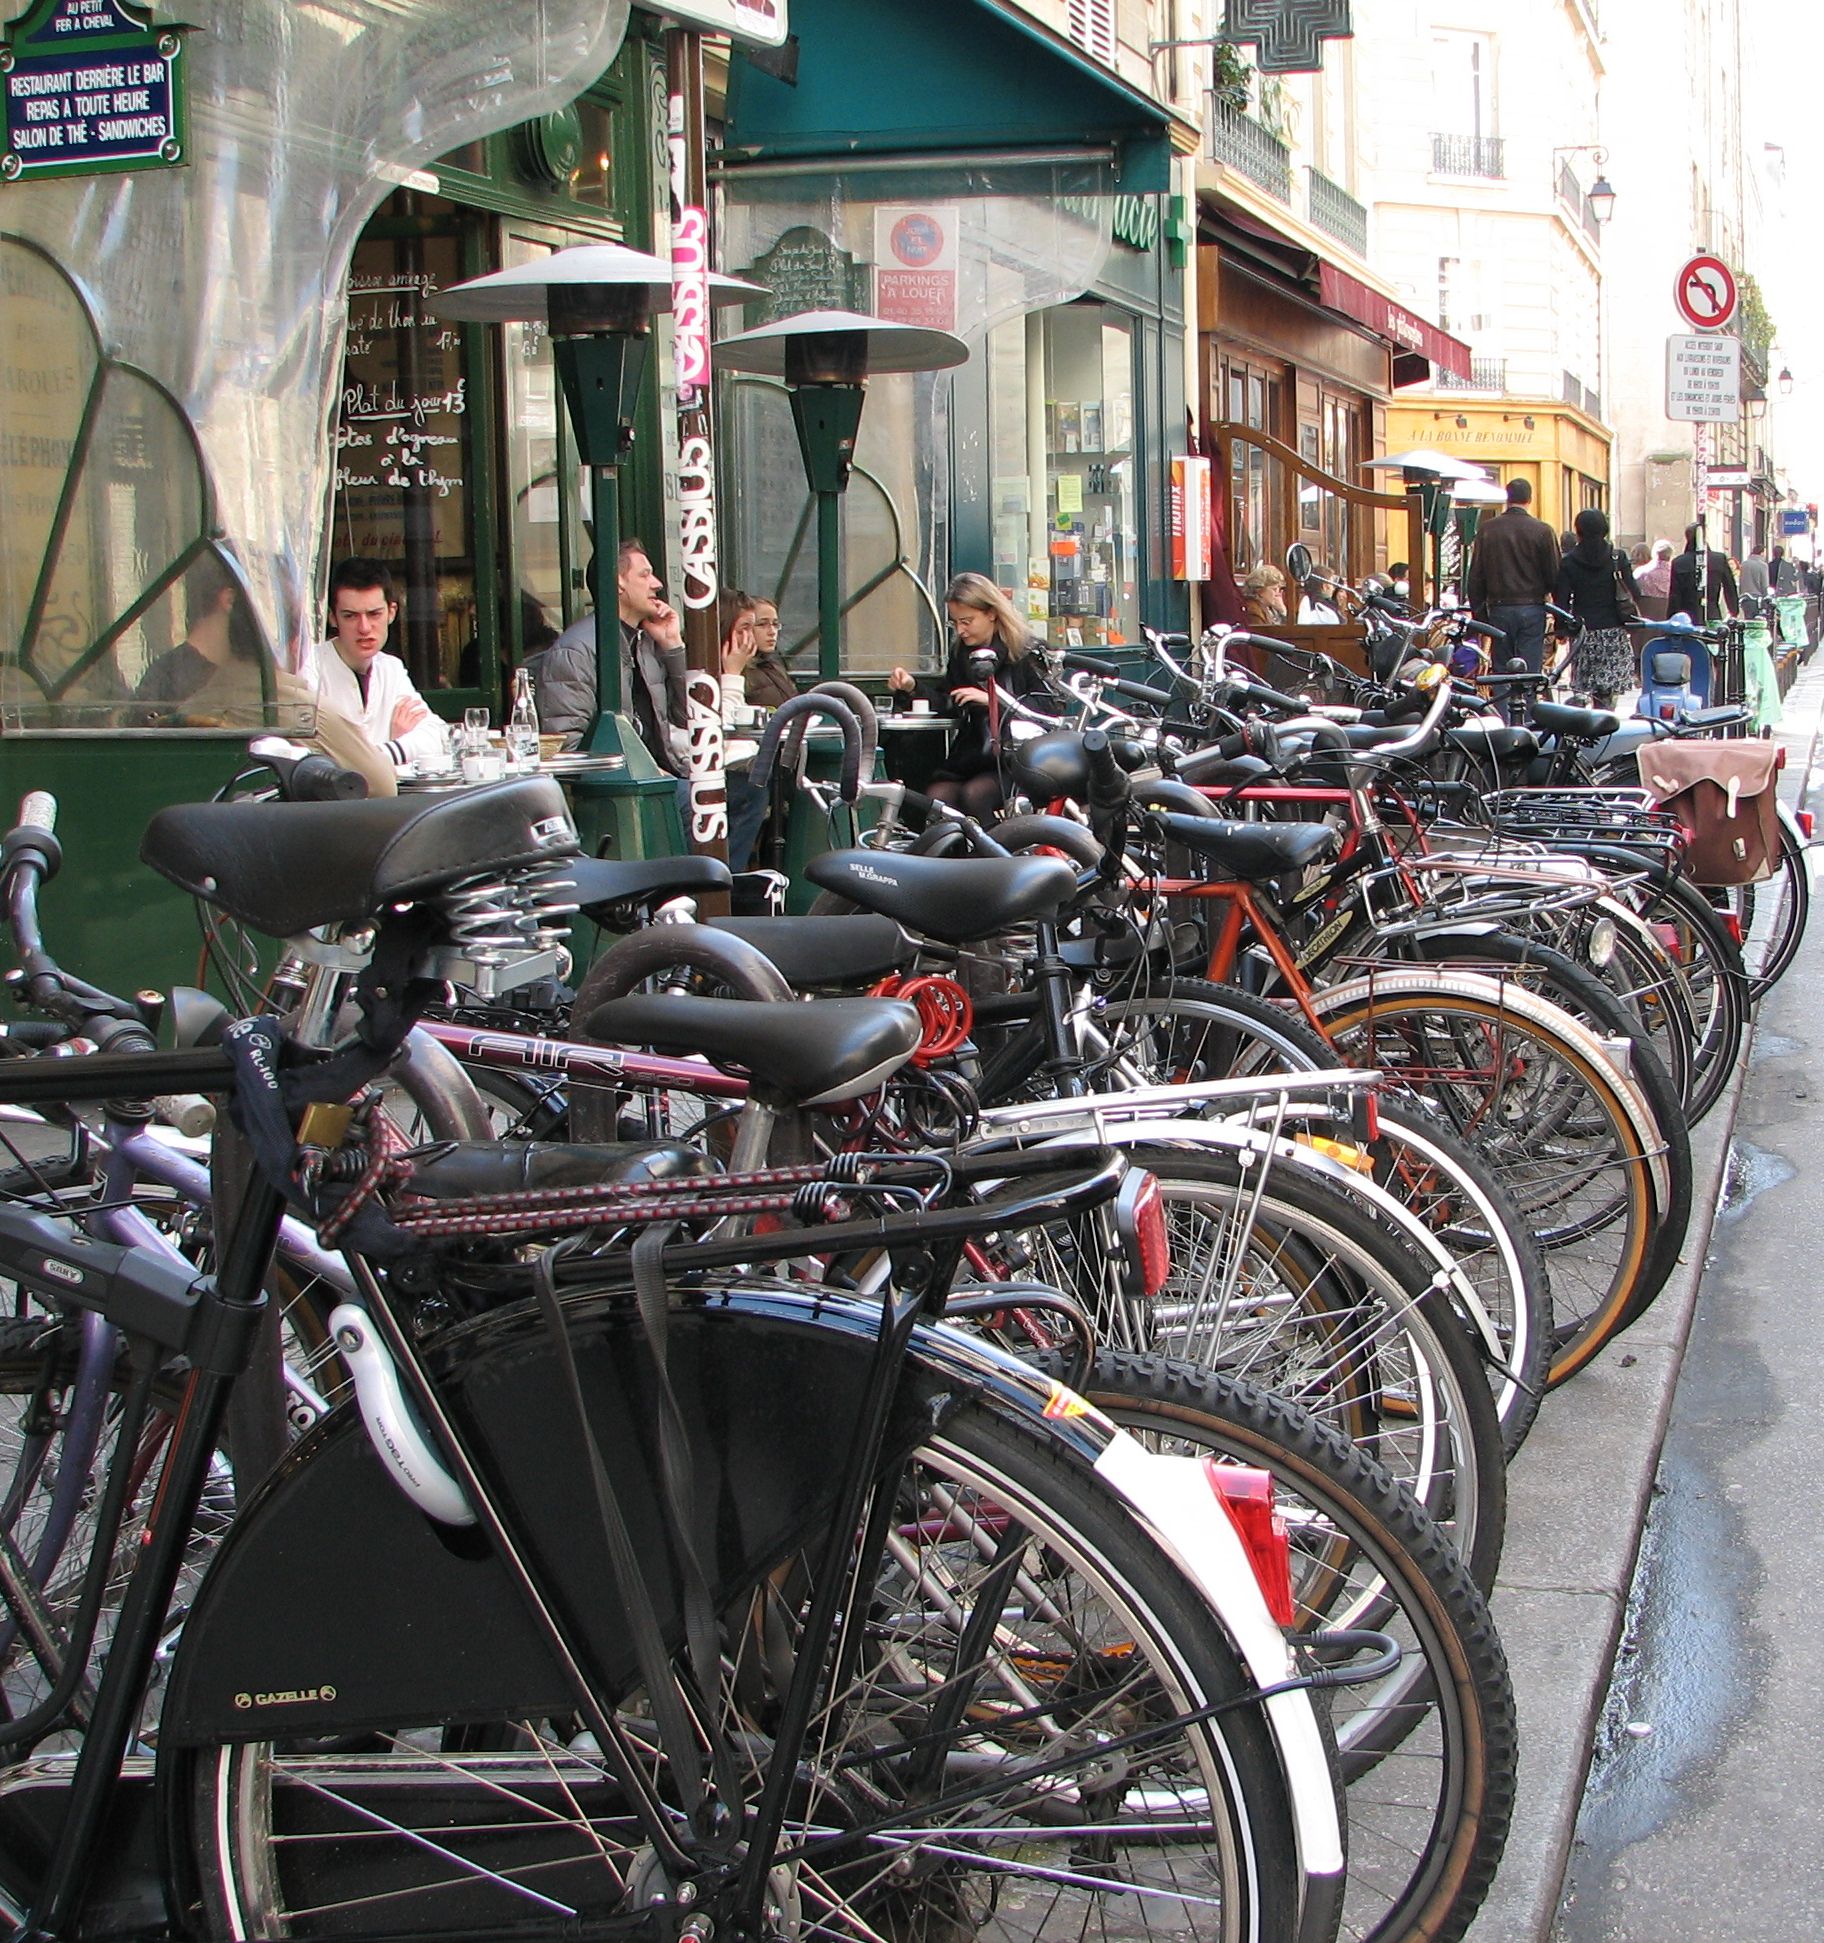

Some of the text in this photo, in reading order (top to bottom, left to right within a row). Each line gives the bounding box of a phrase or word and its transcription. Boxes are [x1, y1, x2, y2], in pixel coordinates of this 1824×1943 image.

[67, 0, 103, 15] AU PETIT
[55, 15, 115, 32] FER A CHEVAL
[11, 62, 165, 97] RESTAURANT DERRIÈRE LE BAR
[26, 90, 150, 122] REPAS A TOUTE HEURE
[13, 128, 47, 150] SALON
[49, 126, 64, 146] DE
[98, 116, 166, 142] SANDWICHES
[672, 208, 707, 384] CASSIUS
[883, 274, 949, 287] PARKINGS
[902, 287, 945, 299] LOUER
[369, 300, 382, 330] de
[388, 300, 415, 329] thon
[344, 383, 381, 414] Plat
[385, 379, 405, 412] du
[411, 393, 443, 427] jour
[386, 426, 459, 453] d'agneau
[1408, 430, 1416, 440] A
[1420, 430, 1433, 441] LA
[1436, 431, 1471, 442] BONNE
[380, 447, 424, 467] à la
[335, 466, 463, 497] fleur de thym
[678, 436, 717, 609] CASSIUS
[1171, 485, 1182, 536] manix
[687, 673, 728, 842] CASSIUS
[1303, 921, 1343, 961] DECATHLON
[469, 1034, 625, 1076] AIR
[255, 1689, 318, 1705] GAZELLE
